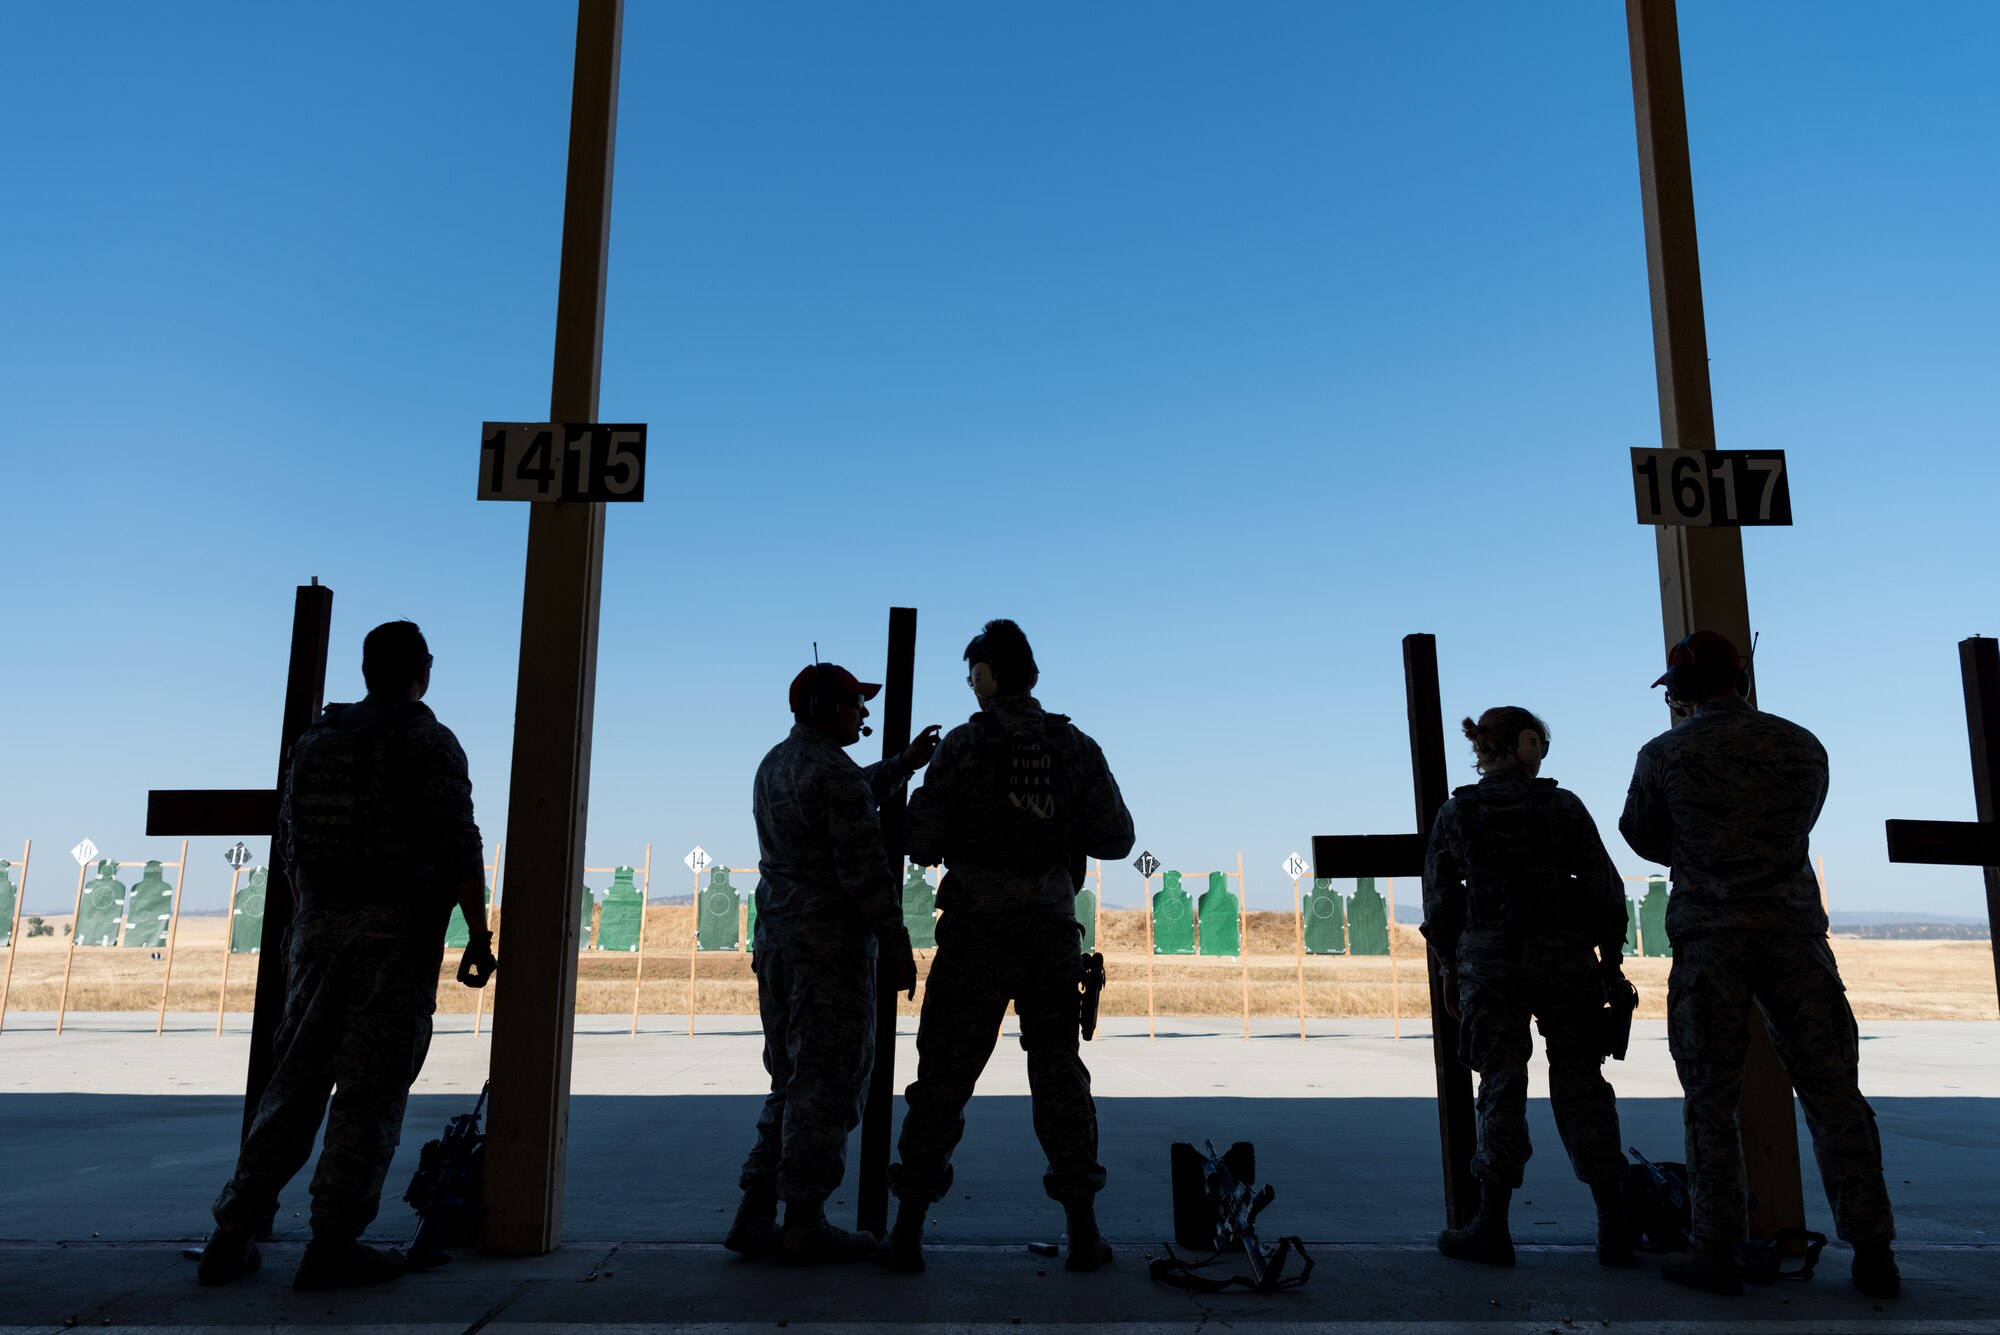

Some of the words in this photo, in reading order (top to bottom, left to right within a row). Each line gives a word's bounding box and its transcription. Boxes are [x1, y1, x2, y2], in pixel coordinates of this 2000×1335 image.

[483, 430, 555, 493] 14
[568, 431, 640, 495] 15
[1637, 455, 1705, 518] 16
[1712, 459, 1783, 520] 17
[78, 842, 92, 860] 10
[231, 846, 245, 865] 11
[692, 851, 705, 869] 14
[1141, 855, 1153, 874] 17
[1289, 857, 1303, 875] 18
